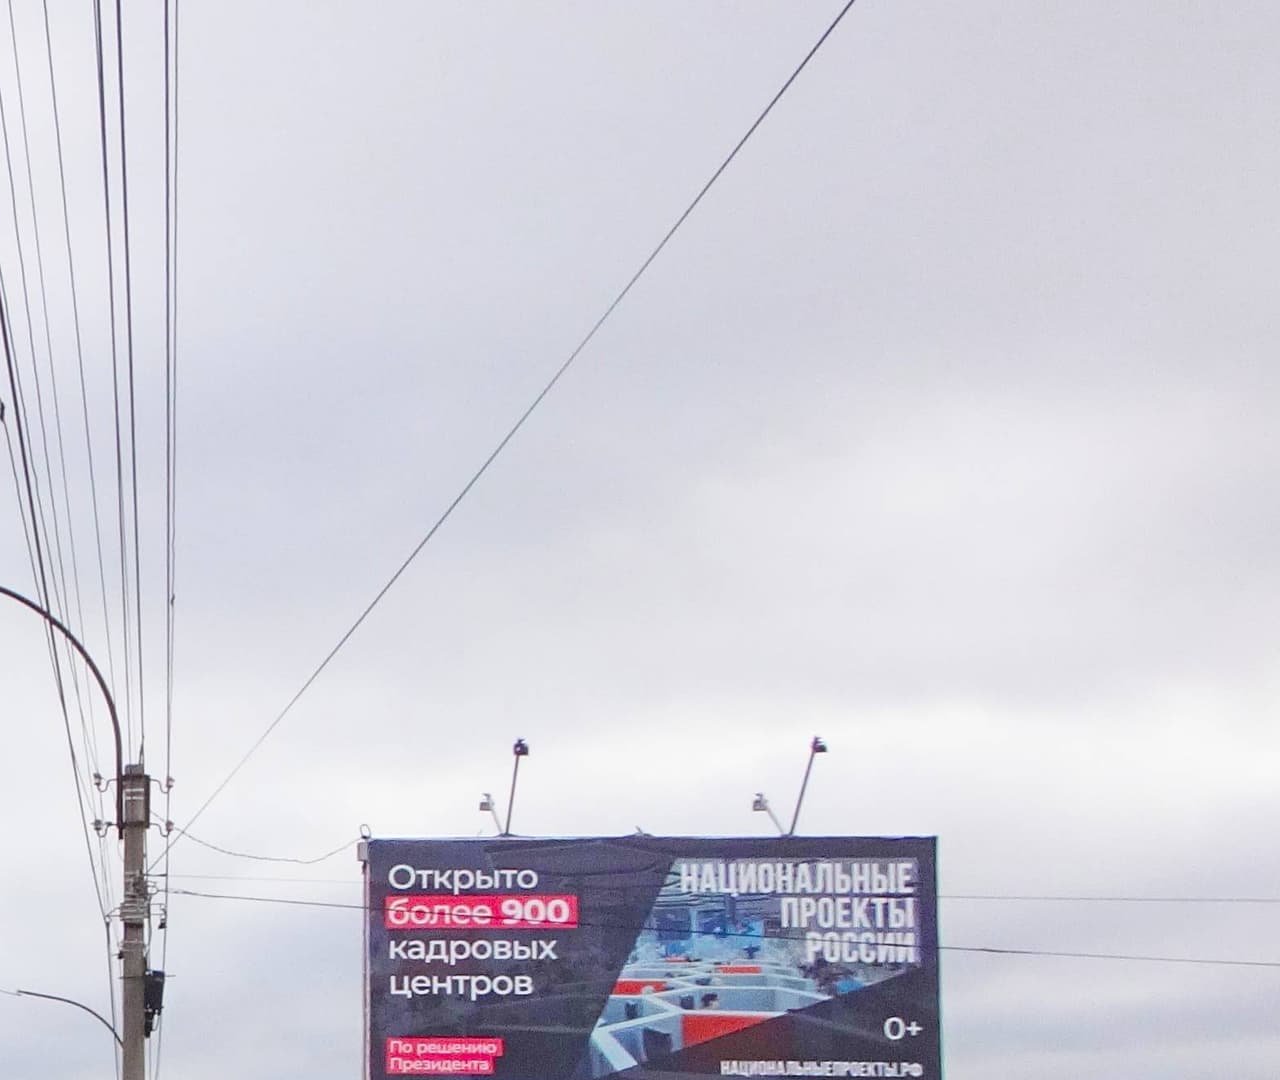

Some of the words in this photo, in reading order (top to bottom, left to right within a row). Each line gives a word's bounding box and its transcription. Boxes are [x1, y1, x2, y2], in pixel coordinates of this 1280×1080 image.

[389, 864, 538, 895] Открыто
[680, 863, 914, 894] НАЦИОНАЛЬНЫЕ
[389, 898, 492, 925] более
[501, 899, 569, 924] 900
[781, 898, 915, 928] ПРОЕКТЫ
[389, 939, 558, 965] кадровых
[806, 931, 916, 963] РОССИИ
[389, 975, 534, 1001] центров
[884, 1016, 923, 1040] 0+
[390, 1040, 413, 1053] По
[416, 1043, 497, 1056] решению
[390, 1057, 489, 1072] Президента
[719, 1060, 924, 1077] НАЦИОНАЛЬНЫЕПРОЕКТЫ.РФ
